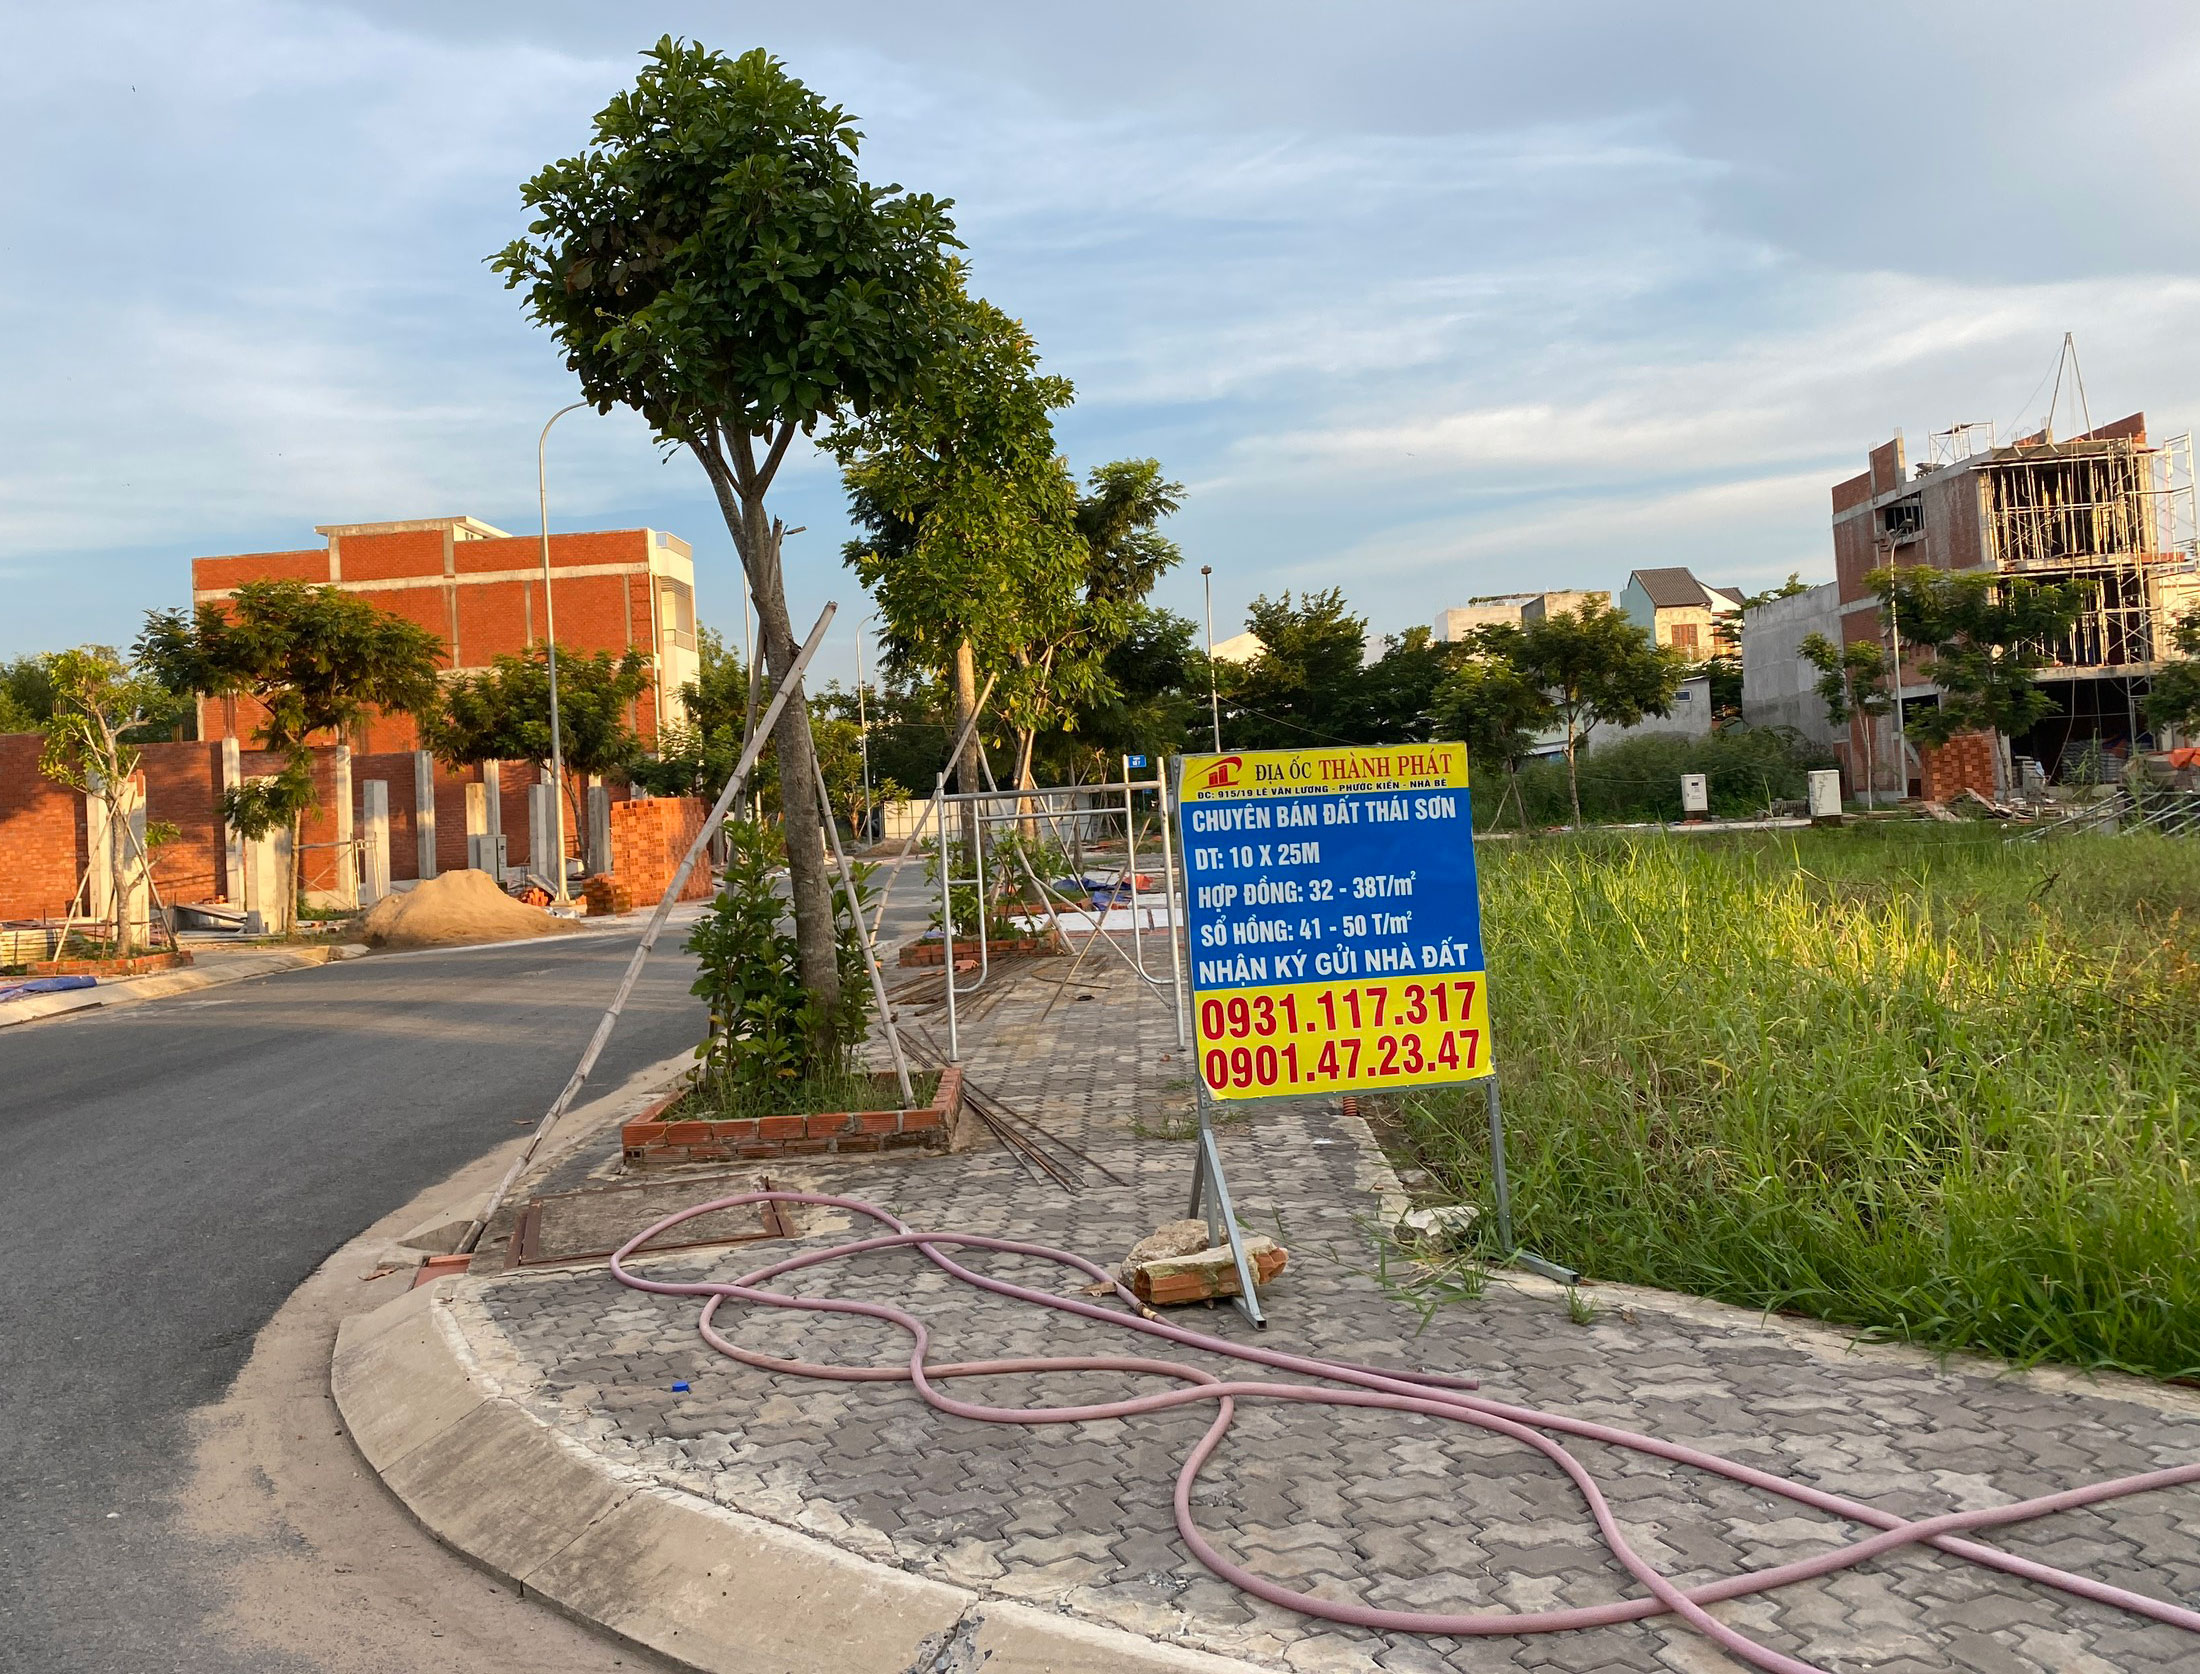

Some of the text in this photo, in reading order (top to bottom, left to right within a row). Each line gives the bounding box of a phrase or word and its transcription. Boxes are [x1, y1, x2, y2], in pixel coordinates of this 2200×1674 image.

[1255, 748, 1452, 784] ĐỊA ỐC THÀNH PHÁT
[1197, 791, 1215, 799] ĐC:
[1218, 789, 1253, 798] 915/19
[1192, 795, 1457, 832] CHUYÊN BÁN ĐẤT THÁI SƠN
[1195, 841, 1320, 871] DT: 10 X 25M
[1198, 882, 1238, 912] HỢP
[1243, 875, 1303, 906] ĐỒNG:
[1308, 879, 1334, 901] 32
[1200, 914, 1228, 947] SỔ
[1233, 914, 1293, 944] HỒNG:
[1299, 917, 1321, 940] 41
[1342, 914, 1367, 937] 50
[1199, 936, 1469, 987] NHẬN KÝ GỬI NHÀ ĐẤT
[1201, 981, 1476, 1040] 0931.117.317
[1205, 1029, 1480, 1090] 0901.47.23.47
